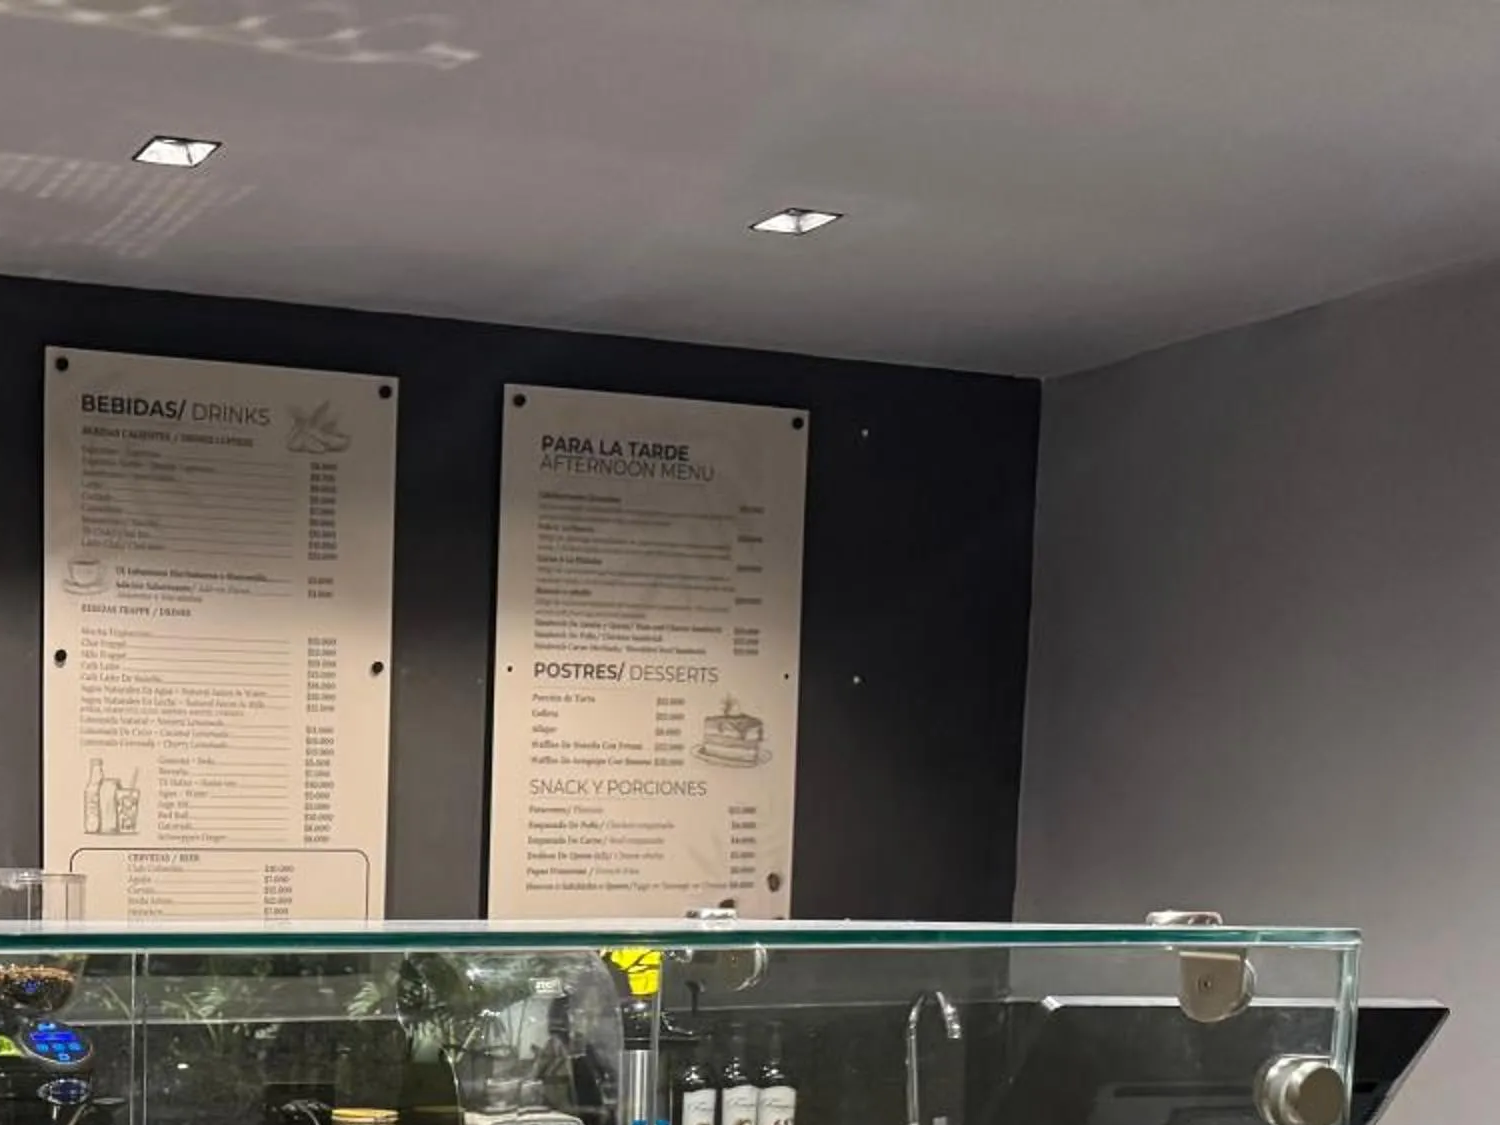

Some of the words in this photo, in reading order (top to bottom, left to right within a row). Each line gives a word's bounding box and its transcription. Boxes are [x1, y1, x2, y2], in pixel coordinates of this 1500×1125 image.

[81, 394, 187, 421] BEBIDAS/
[191, 402, 271, 426] DRINKS
[541, 435, 594, 454] PARA
[599, 439, 623, 457] LA
[628, 441, 690, 461] TARDE
[540, 454, 656, 478] AFTERNOON
[661, 463, 715, 481] MENU
[533, 661, 625, 682] POSTRES/
[629, 664, 720, 684] DESSERTS
[529, 778, 589, 796] SNACK
[591, 779, 603, 795] Y
[607, 779, 708, 797] PORCIONES
